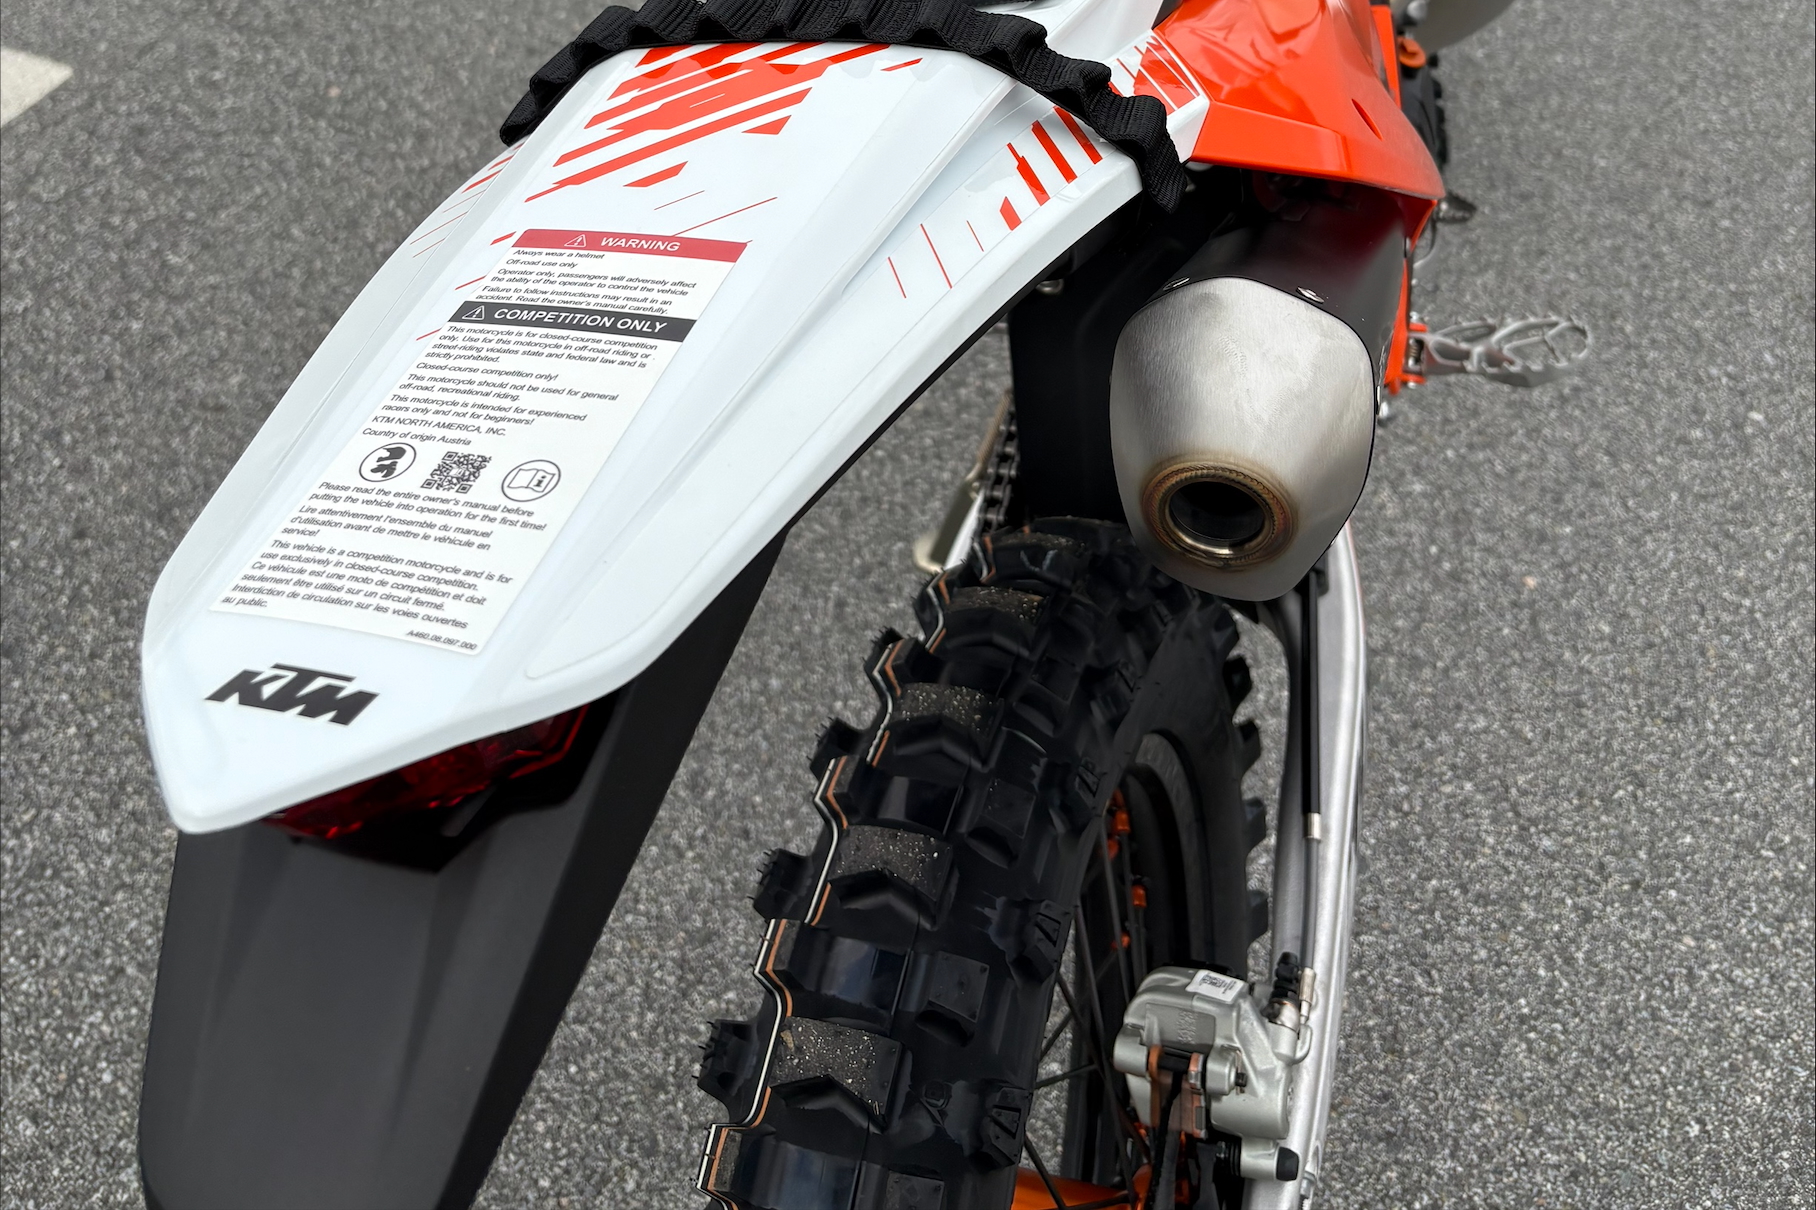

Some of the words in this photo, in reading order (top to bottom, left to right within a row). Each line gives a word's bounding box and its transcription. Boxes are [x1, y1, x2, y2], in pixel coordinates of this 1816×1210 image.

[512, 249, 543, 257] Always
[600, 237, 680, 251] WARNING
[505, 258, 541, 266] Off-road
[558, 261, 578, 269] only
[535, 270, 555, 278] only,
[556, 272, 609, 281] passengers
[625, 277, 669, 287] adversely
[670, 280, 697, 288] affect
[494, 308, 615, 327] COMPETITION
[616, 318, 667, 332] ONLY
[447, 325, 465, 333] This
[465, 328, 514, 337] motorcycle
[524, 330, 538, 338] for
[538, 332, 603, 344] closed-course
[603, 339, 658, 350] competition
[424, 351, 454, 360] strictly
[452, 353, 500, 363] prohibited.
[431, 342, 484, 353] street-riding
[485, 346, 520, 355] violates
[520, 349, 545, 357] state
[565, 352, 599, 362] federal
[599, 356, 617, 364] law
[416, 362, 480, 373] Closed-course
[480, 368, 534, 378] competition
[534, 373, 559, 382] only!
[398, 382, 435, 392] off-road,
[437, 386, 493, 397] recreational
[492, 391, 520, 402] riding.
[407, 373, 426, 381] This
[426, 376, 476, 386] motorcycle
[476, 379, 509, 389] should
[526, 384, 540, 392] be
[540, 387, 566, 395] used
[566, 388, 581, 396] for
[580, 391, 619, 401] general
[381, 404, 410, 412] racers
[411, 406, 432, 415] only
[468, 411, 483, 419] for
[483, 413, 535, 425] beginners!
[390, 394, 409, 402] This
[409, 397, 460, 407] motorcycle
[459, 400, 469, 408] is
[470, 401, 513, 413] intended
[512, 406, 528, 414] for
[527, 409, 588, 421] experienced
[362, 427, 399, 439] Country
[409, 433, 437, 442] origin
[436, 435, 472, 446] Austria
[371, 415, 396, 423] KTM
[394, 417, 434, 427] NORTH
[432, 421, 482, 434] AMERICA,
[484, 426, 506, 436] INC.
[318, 481, 351, 492] Please
[351, 486, 376, 494] read
[375, 488, 392, 497] the
[392, 491, 421, 500] entire
[421, 495, 461, 506] owner's
[461, 500, 501, 511] manual
[500, 505, 534, 517] before
[298, 505, 318, 514] Lire
[317, 508, 384, 522] attentivement
[383, 515, 437, 530] l'ensemble
[438, 523, 453, 532] du
[453, 526, 493, 538] manuel
[308, 493, 343, 503] putting
[343, 495, 359, 504] the
[361, 498, 395, 508] vehicle
[395, 501, 415, 511] into
[415, 505, 463, 518] operation
[463, 511, 480, 520] for
[480, 514, 497, 523] the
[498, 516, 520, 527] first
[519, 520, 547, 531] time!
[281, 527, 320, 536] service!
[290, 515, 343, 528] d'utilisation
[343, 523, 372, 532] avant
[372, 525, 386, 534] de
[386, 528, 420, 539] mettre
[420, 532, 432, 541] le
[433, 535, 475, 548] véhicule
[476, 542, 491, 550] en
[271, 539, 291, 549] This
[292, 543, 326, 553] vehicle
[326, 546, 337, 555] is
[346, 550, 404, 565] competition
[404, 559, 462, 574] motorcycle
[462, 569, 485, 579] and
[484, 571, 495, 581] is
[496, 573, 513, 583] for
[279, 554, 333, 568] exclusively
[333, 559, 344, 568] in
[344, 561, 415, 579] closed-course
[416, 574, 478, 591] competition.
[241, 574, 293, 585] seulement
[292, 578, 313, 588] être
[313, 582, 345, 592] utilisé
[344, 587, 364, 595] sur
[363, 590, 378, 598] un
[379, 592, 412, 604] circuit
[411, 597, 444, 611] fermé.
[251, 561, 266, 570] Ce
[267, 563, 307, 575] véhicule
[308, 569, 326, 577] est
[325, 572, 346, 580] une
[346, 575, 374, 585] moto
[374, 578, 389, 587] de
[390, 582, 451, 598] compétition
[451, 593, 464, 601] et
[464, 595, 487, 605] doit
[231, 583, 286, 596] Interdiction
[286, 590, 300, 599] de
[301, 593, 354, 606] circulation
[354, 601, 373, 610] sur
[372, 603, 390, 613] les
[392, 608, 420, 619] voies
[421, 613, 468, 629] ouvertes
[235, 598, 267, 607] public.
[204, 663, 380, 726] KTM
